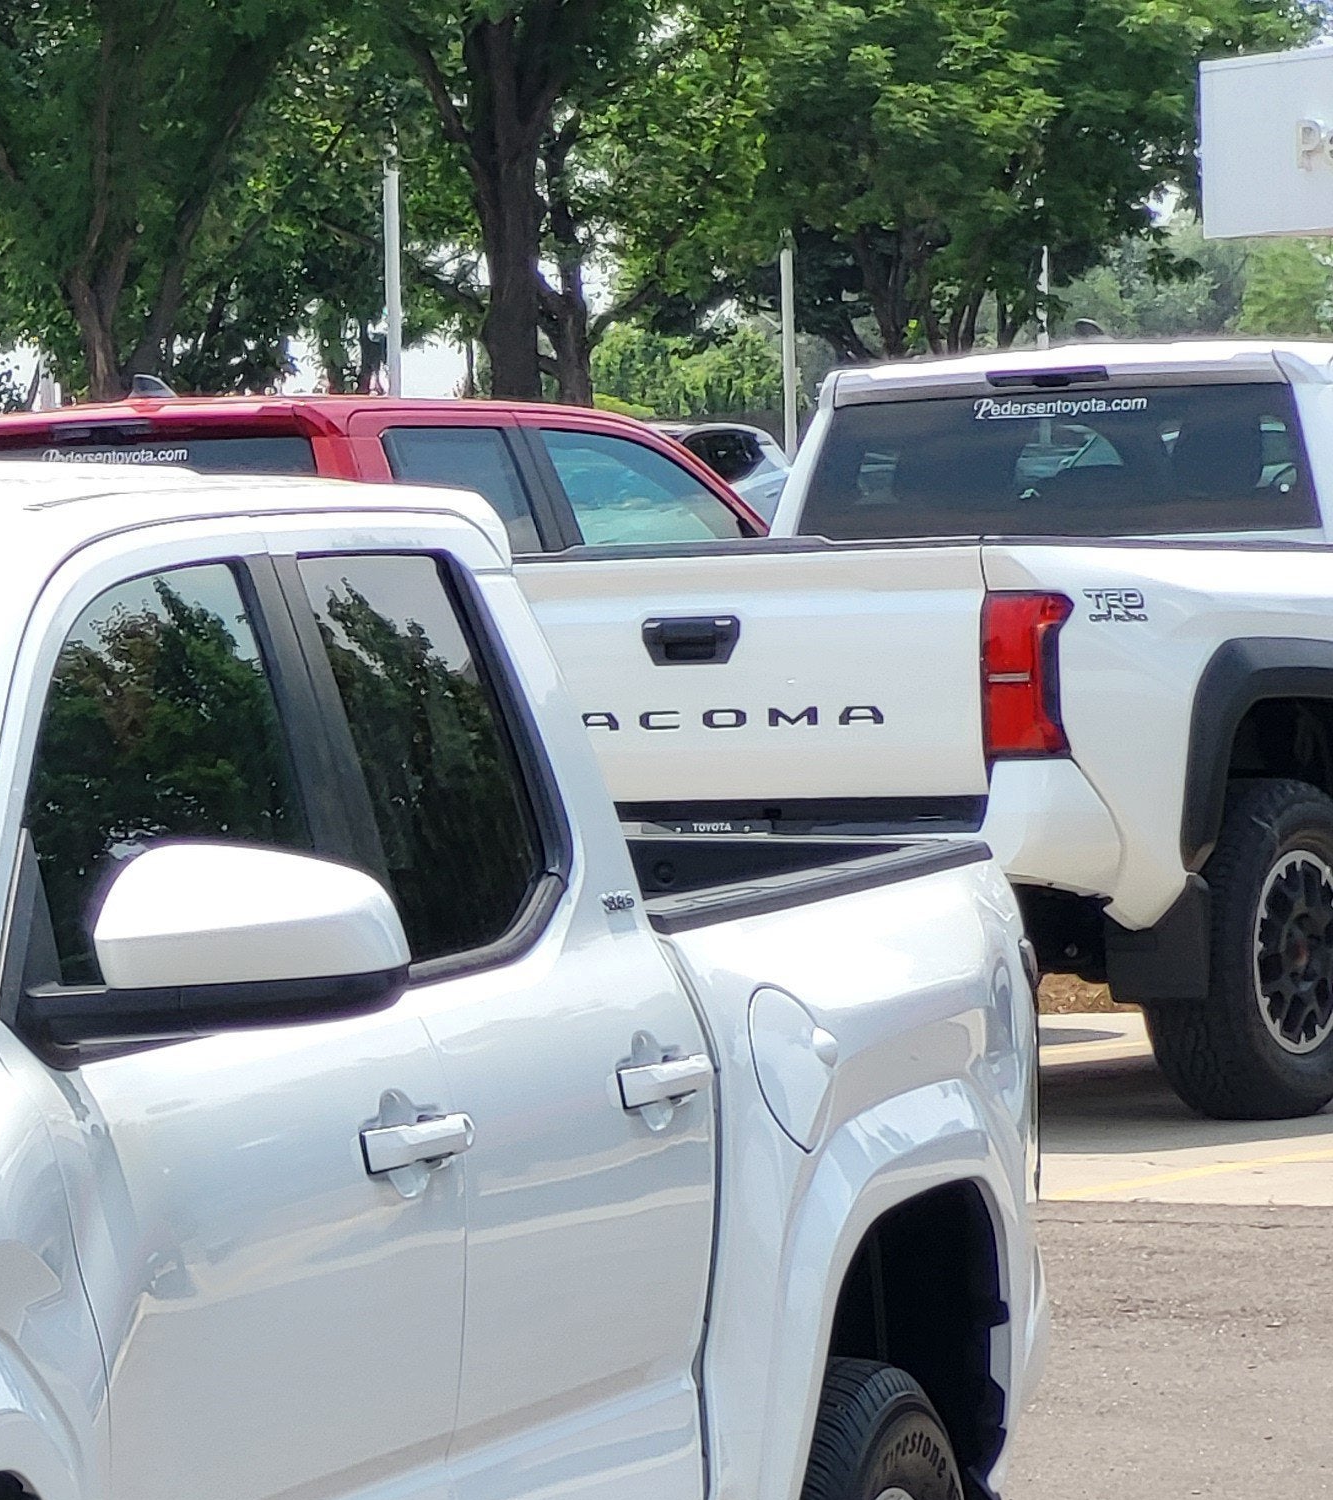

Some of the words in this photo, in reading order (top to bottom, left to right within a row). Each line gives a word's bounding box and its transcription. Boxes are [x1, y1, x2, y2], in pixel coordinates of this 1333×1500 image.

[971, 398, 1147, 419] Pedersentoyota.com
[1082, 588, 1144, 614] TRD
[581, 706, 884, 731] ACOMA
[692, 822, 732, 832] TOYOTA
